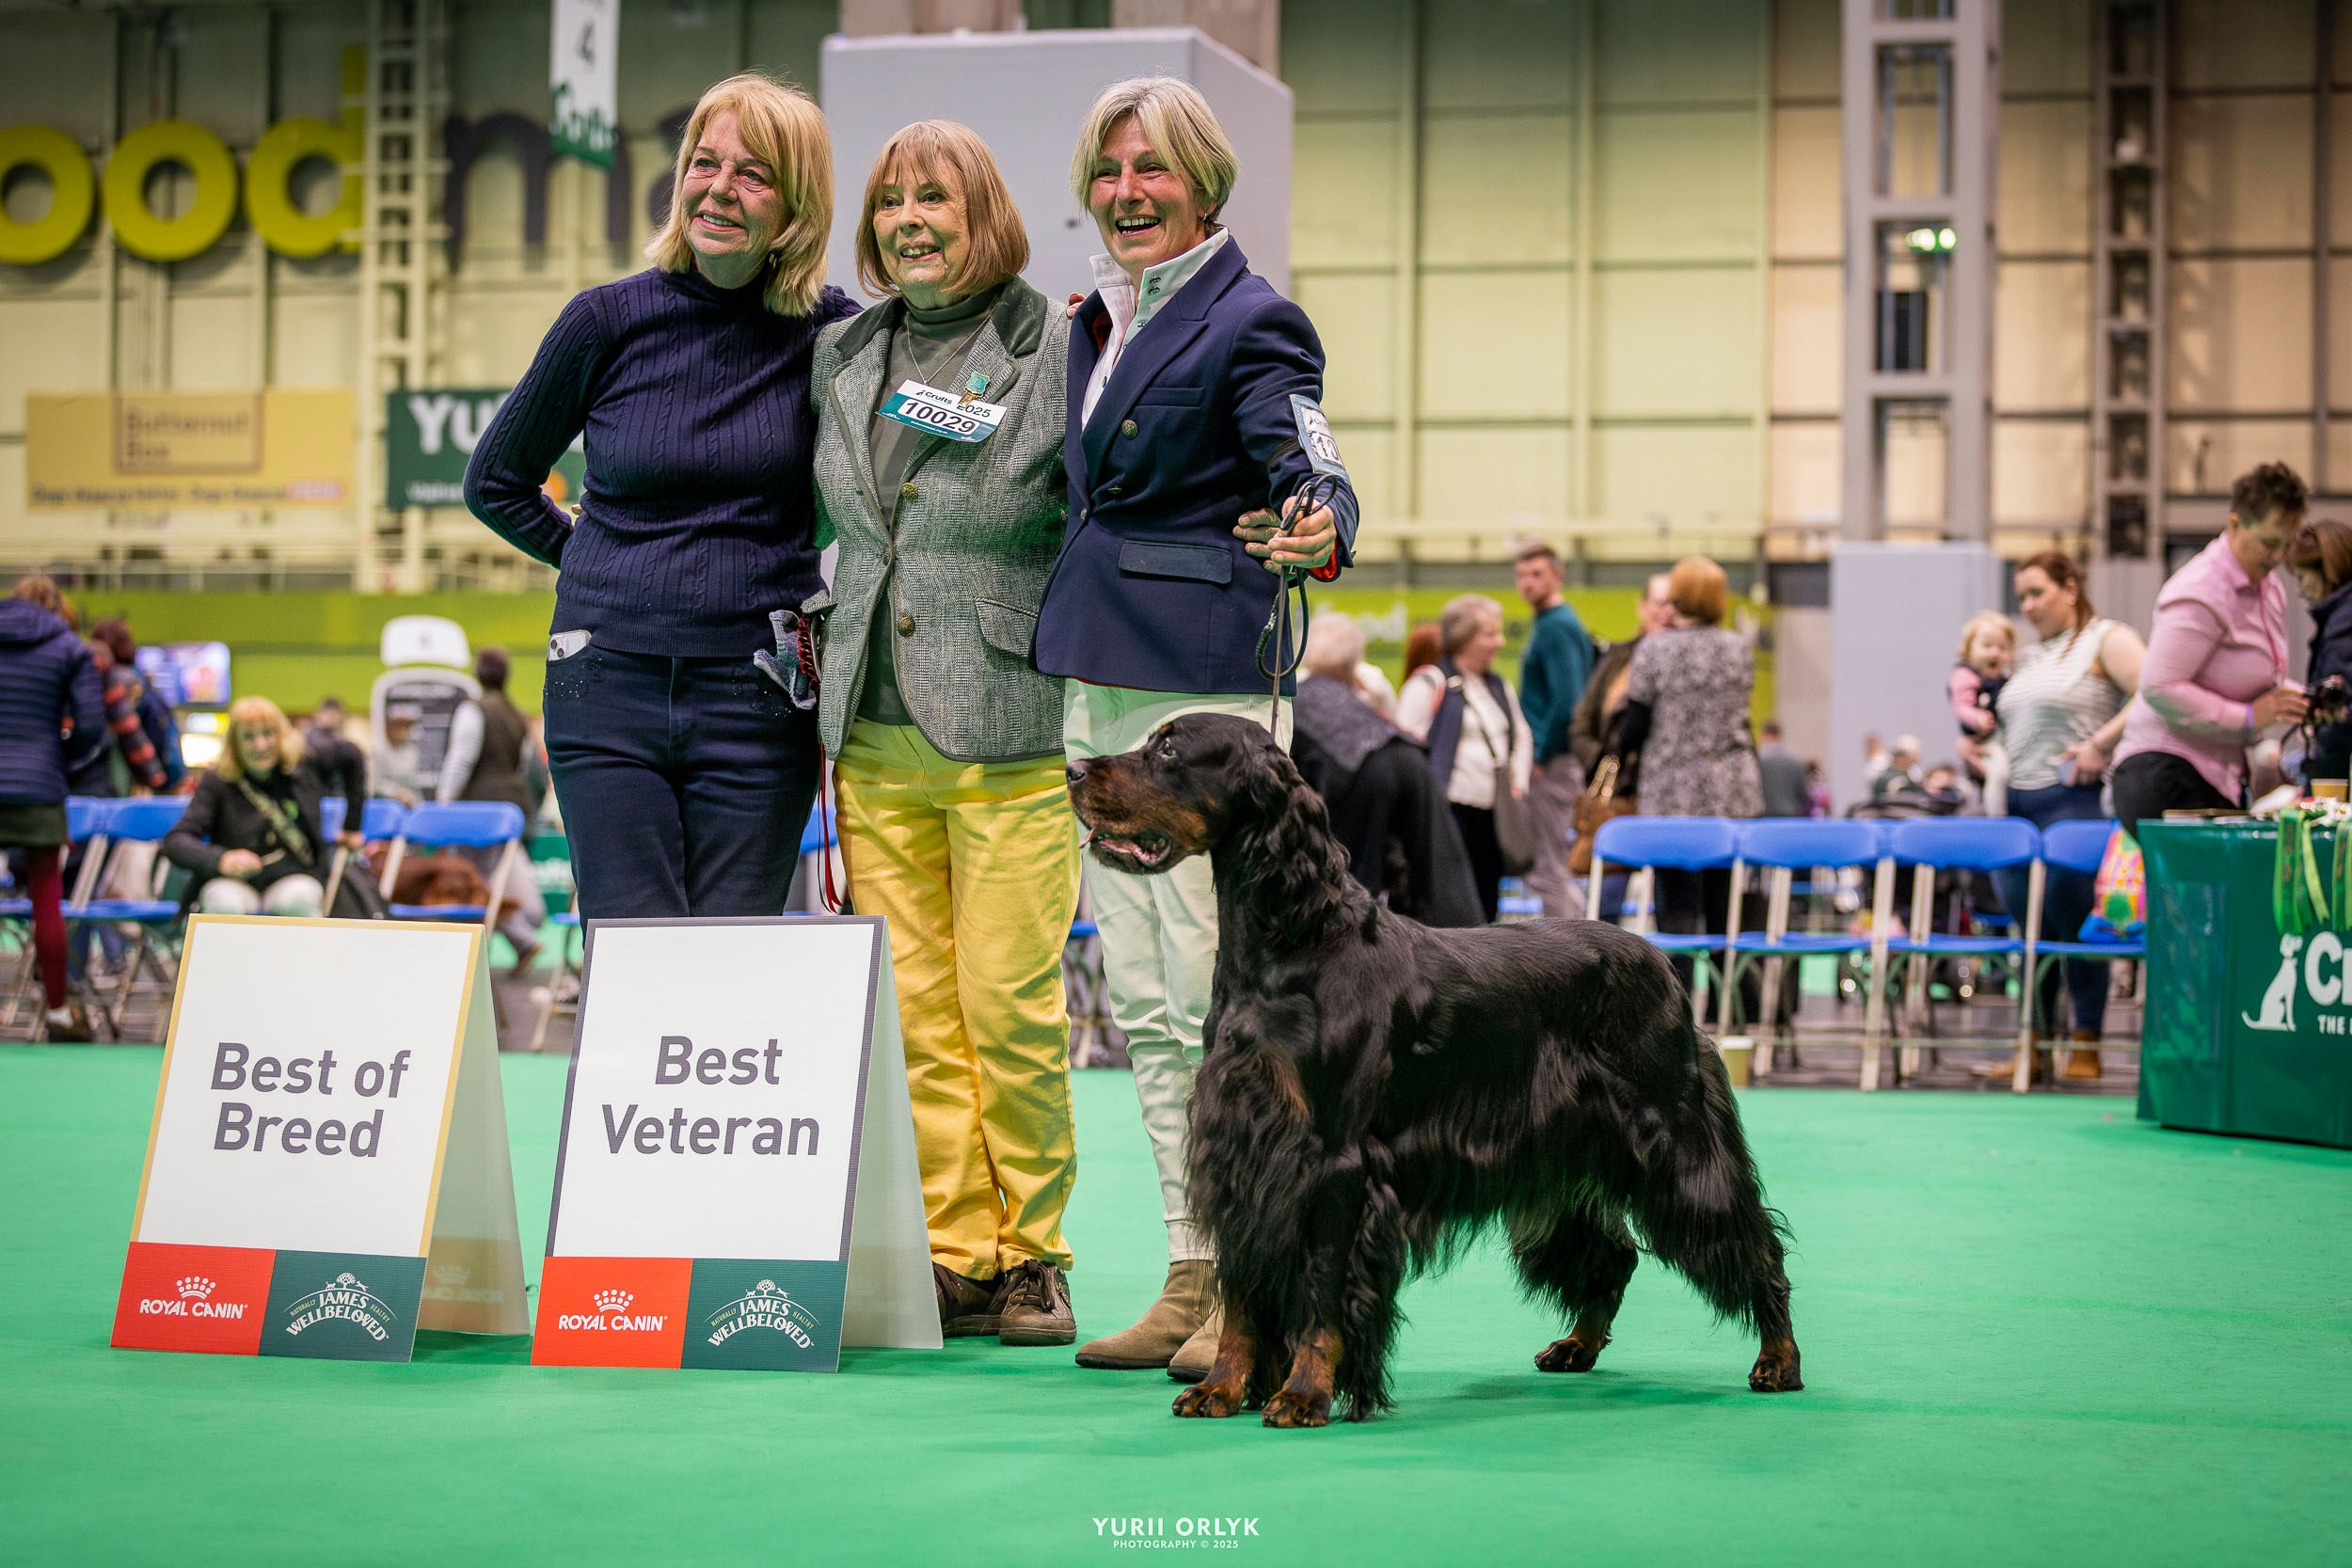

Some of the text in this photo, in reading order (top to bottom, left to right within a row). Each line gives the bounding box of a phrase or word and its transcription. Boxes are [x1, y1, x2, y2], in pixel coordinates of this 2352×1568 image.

[925, 390, 953, 405] Crufts
[905, 402, 977, 434] 10029
[2317, 1014, 2346, 1036] THE
[211, 1041, 412, 1099] Best of
[655, 1036, 783, 1085] Best
[214, 1101, 385, 1158] Breed
[601, 1103, 819, 1156] Veteran
[139, 1298, 245, 1320] ROYAL CANIN
[290, 1299, 317, 1317] NATURALLY
[318, 1291, 370, 1310] JAMES
[739, 1298, 792, 1318] JAMES
[285, 1305, 388, 1341] WELLBELOVED
[370, 1303, 391, 1323] HEALTHY
[558, 1314, 664, 1332] ROYAL CANIN
[710, 1307, 738, 1327] NATURALLY
[791, 1310, 816, 1330] HEALTHY
[707, 1312, 811, 1349] WELLBELOVED
